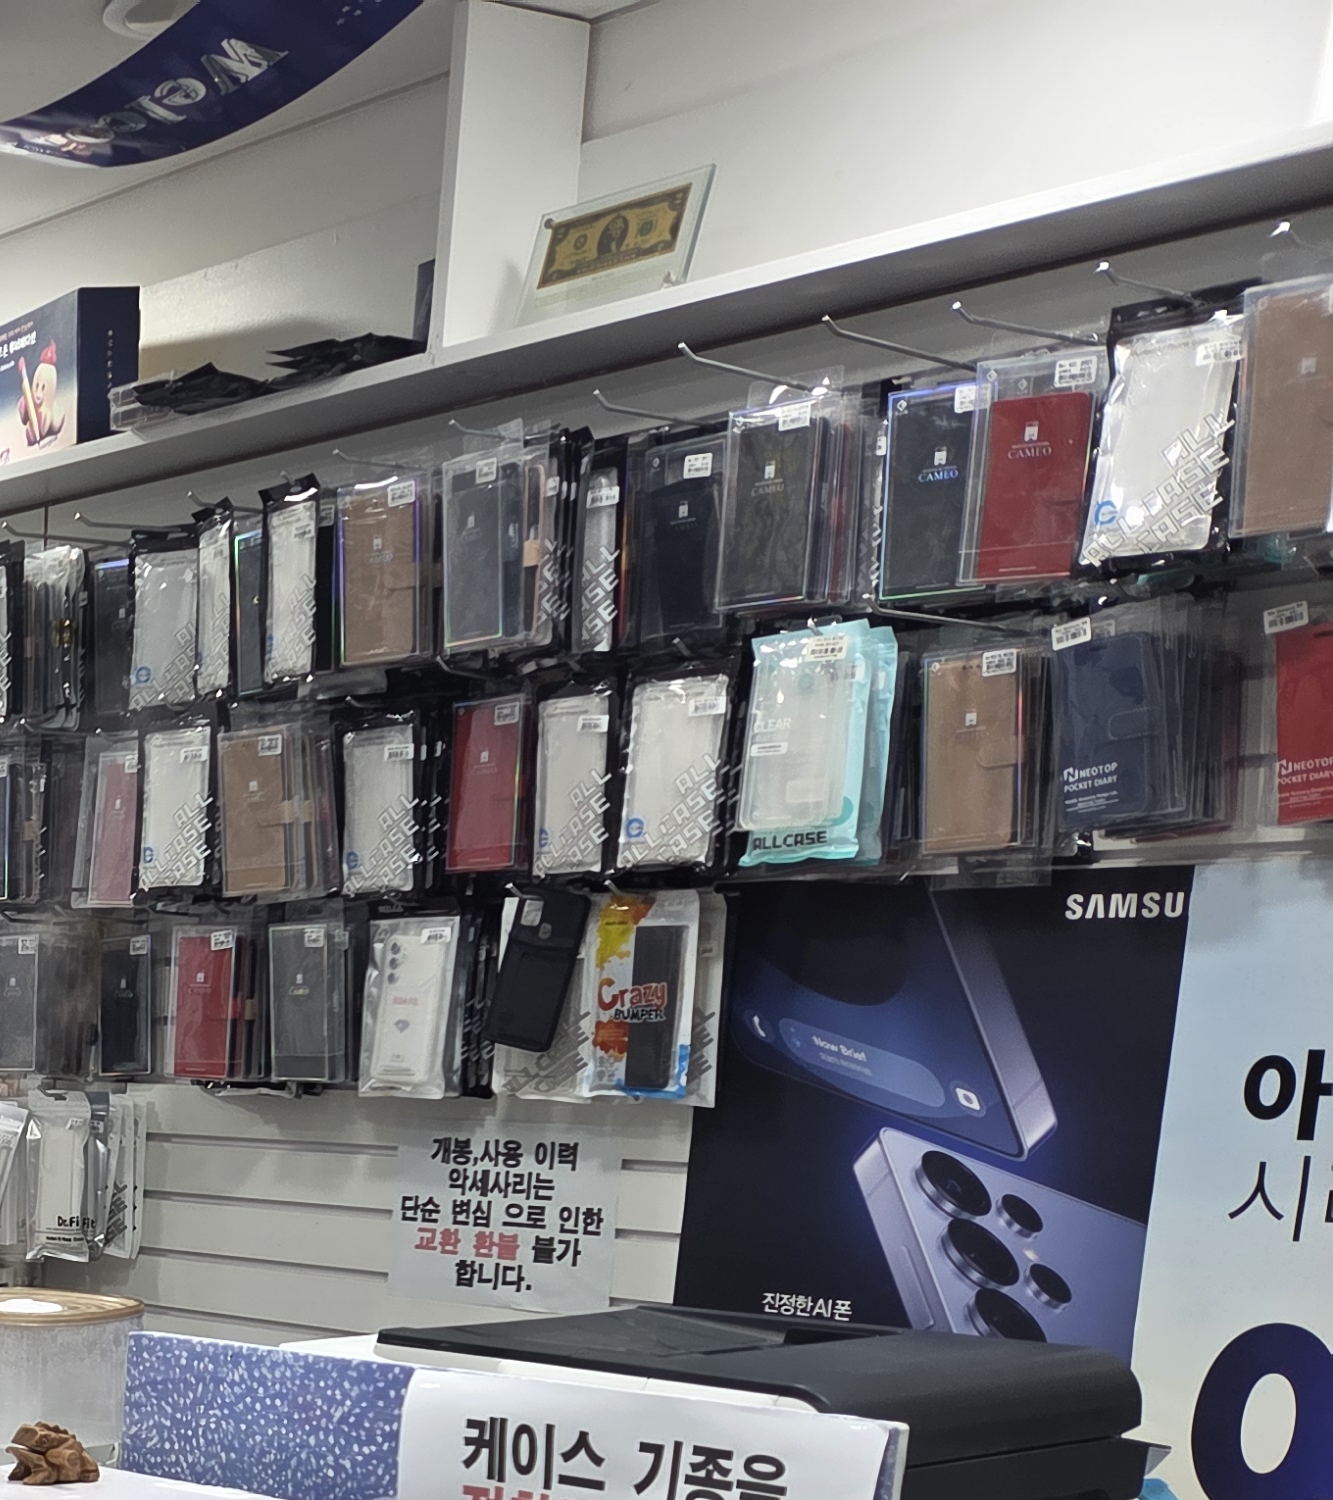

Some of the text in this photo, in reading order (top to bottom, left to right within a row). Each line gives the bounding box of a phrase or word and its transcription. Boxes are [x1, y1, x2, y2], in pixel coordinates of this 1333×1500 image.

[1007, 446, 1052, 459] CAMEO
[918, 469, 959, 482] CAMEO
[1079, 762, 1118, 779] NEOTOP
[597, 975, 669, 1012] Crazy
[614, 1005, 665, 1023] BUMPER
[813, 1034, 839, 1054] Now
[430, 1137, 579, 1171] 개봉,사용 이력
[448, 1168, 555, 1201] 악세사리는
[401, 1195, 604, 1236] 단순 변심 으로 인한
[414, 1227, 582, 1267] 교환 환불 불가
[455, 1259, 532, 1293] 합니다.
[462, 1416, 606, 1491] 케이스
